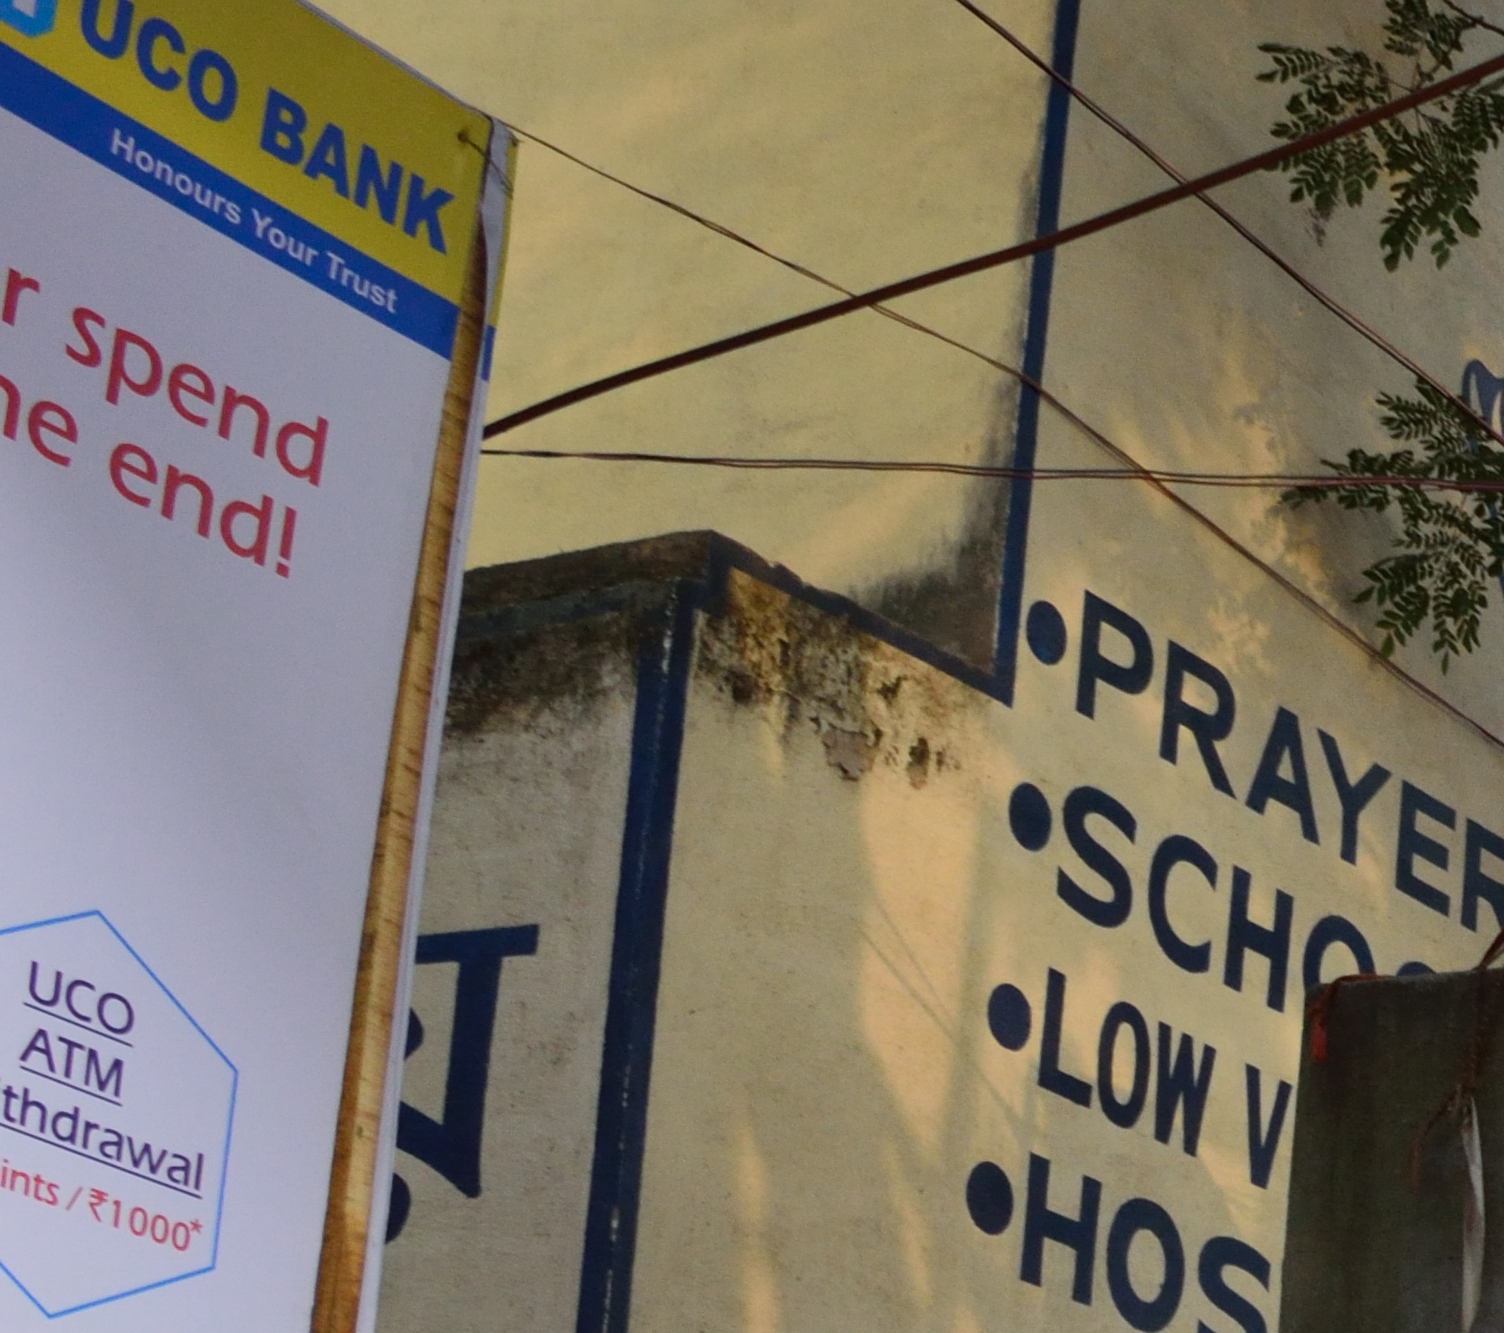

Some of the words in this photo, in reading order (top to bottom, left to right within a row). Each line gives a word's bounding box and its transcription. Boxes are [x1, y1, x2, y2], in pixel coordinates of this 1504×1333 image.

[79, 0, 238, 123] UCO
[259, 88, 454, 256] BANK
[110, 127, 241, 227] Honours
[250, 208, 318, 268] Your
[325, 250, 399, 316] Trust
[65, 306, 329, 488] spend
[109, 442, 298, 580] end!
[1055, 786, 1438, 1014] SCHO
[20, 1028, 124, 1098] ATM
[28, 960, 135, 1035] UCO
[1036, 967, 1216, 1158] LOW
[3, 1085, 204, 1190] thdrawal
